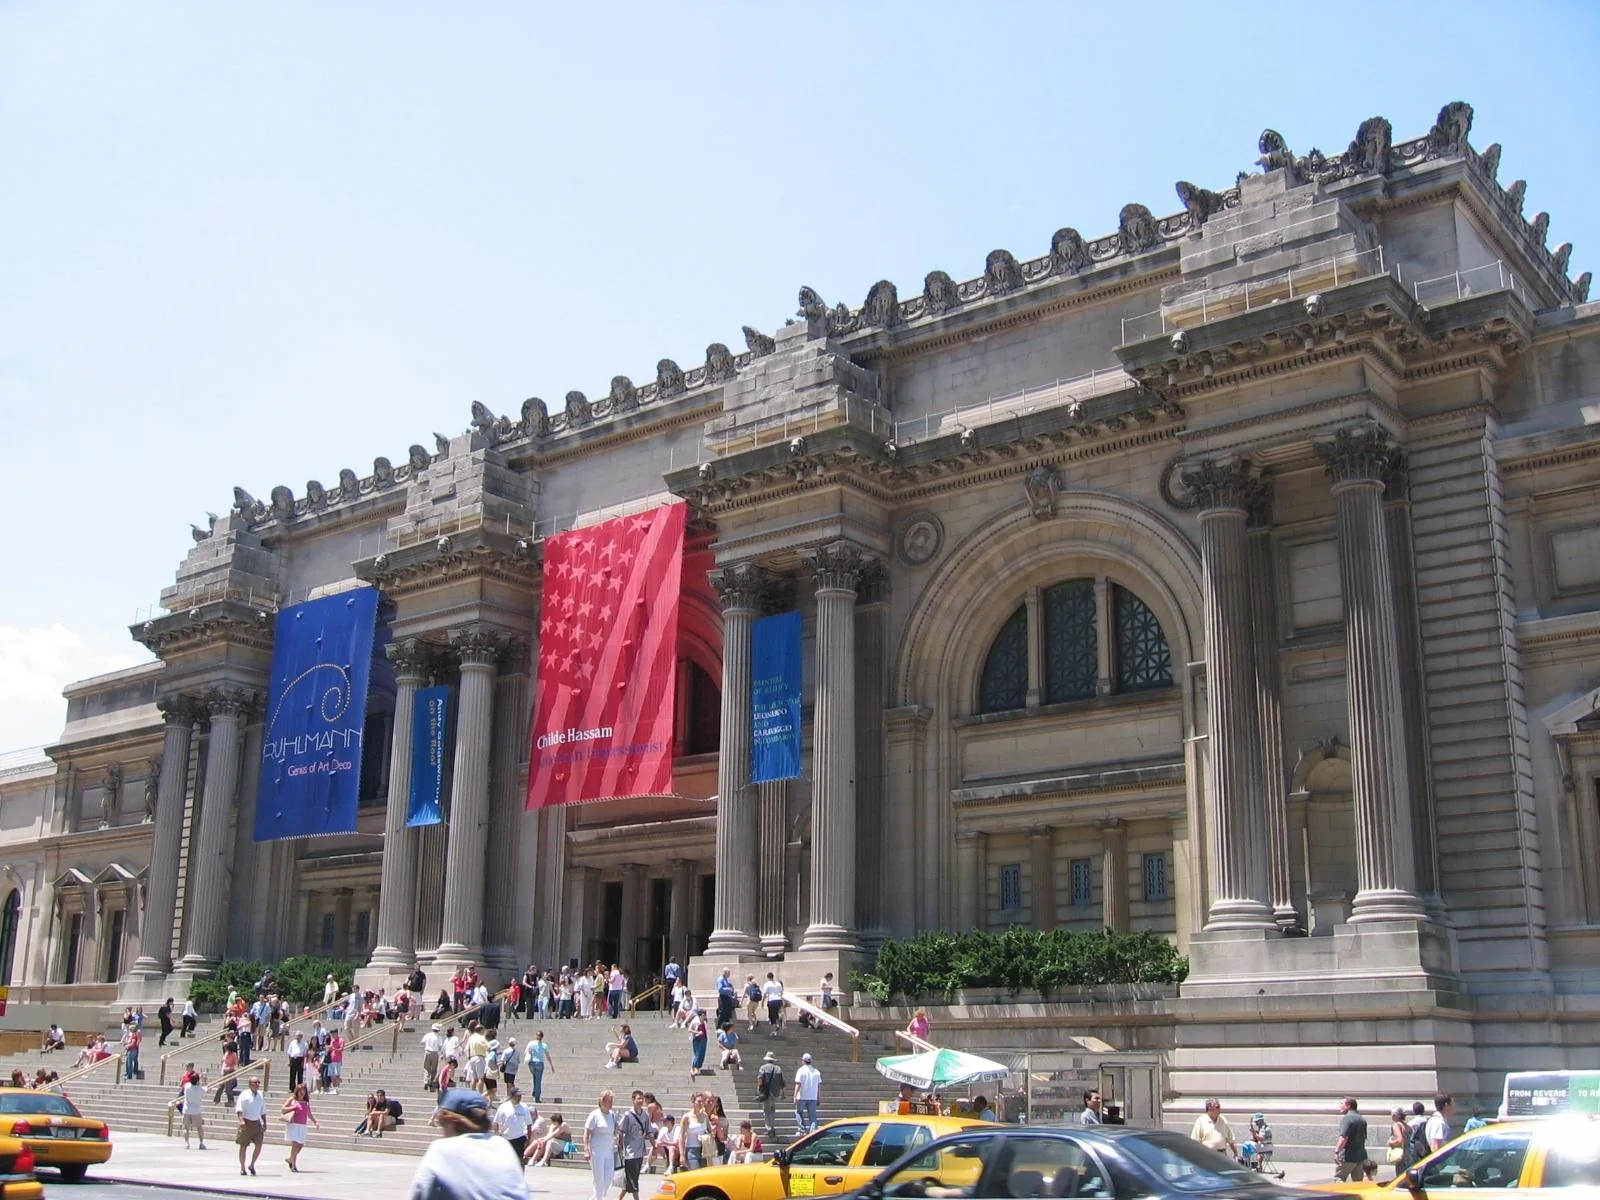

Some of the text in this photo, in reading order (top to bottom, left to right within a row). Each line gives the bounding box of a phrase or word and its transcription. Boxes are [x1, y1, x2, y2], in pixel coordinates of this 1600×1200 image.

[262, 727, 363, 764] RUHLMANN
[537, 726, 613, 750] Childe Hassam
[309, 761, 316, 773] of
[317, 761, 330, 773] Art
[331, 758, 352, 770] Deco
